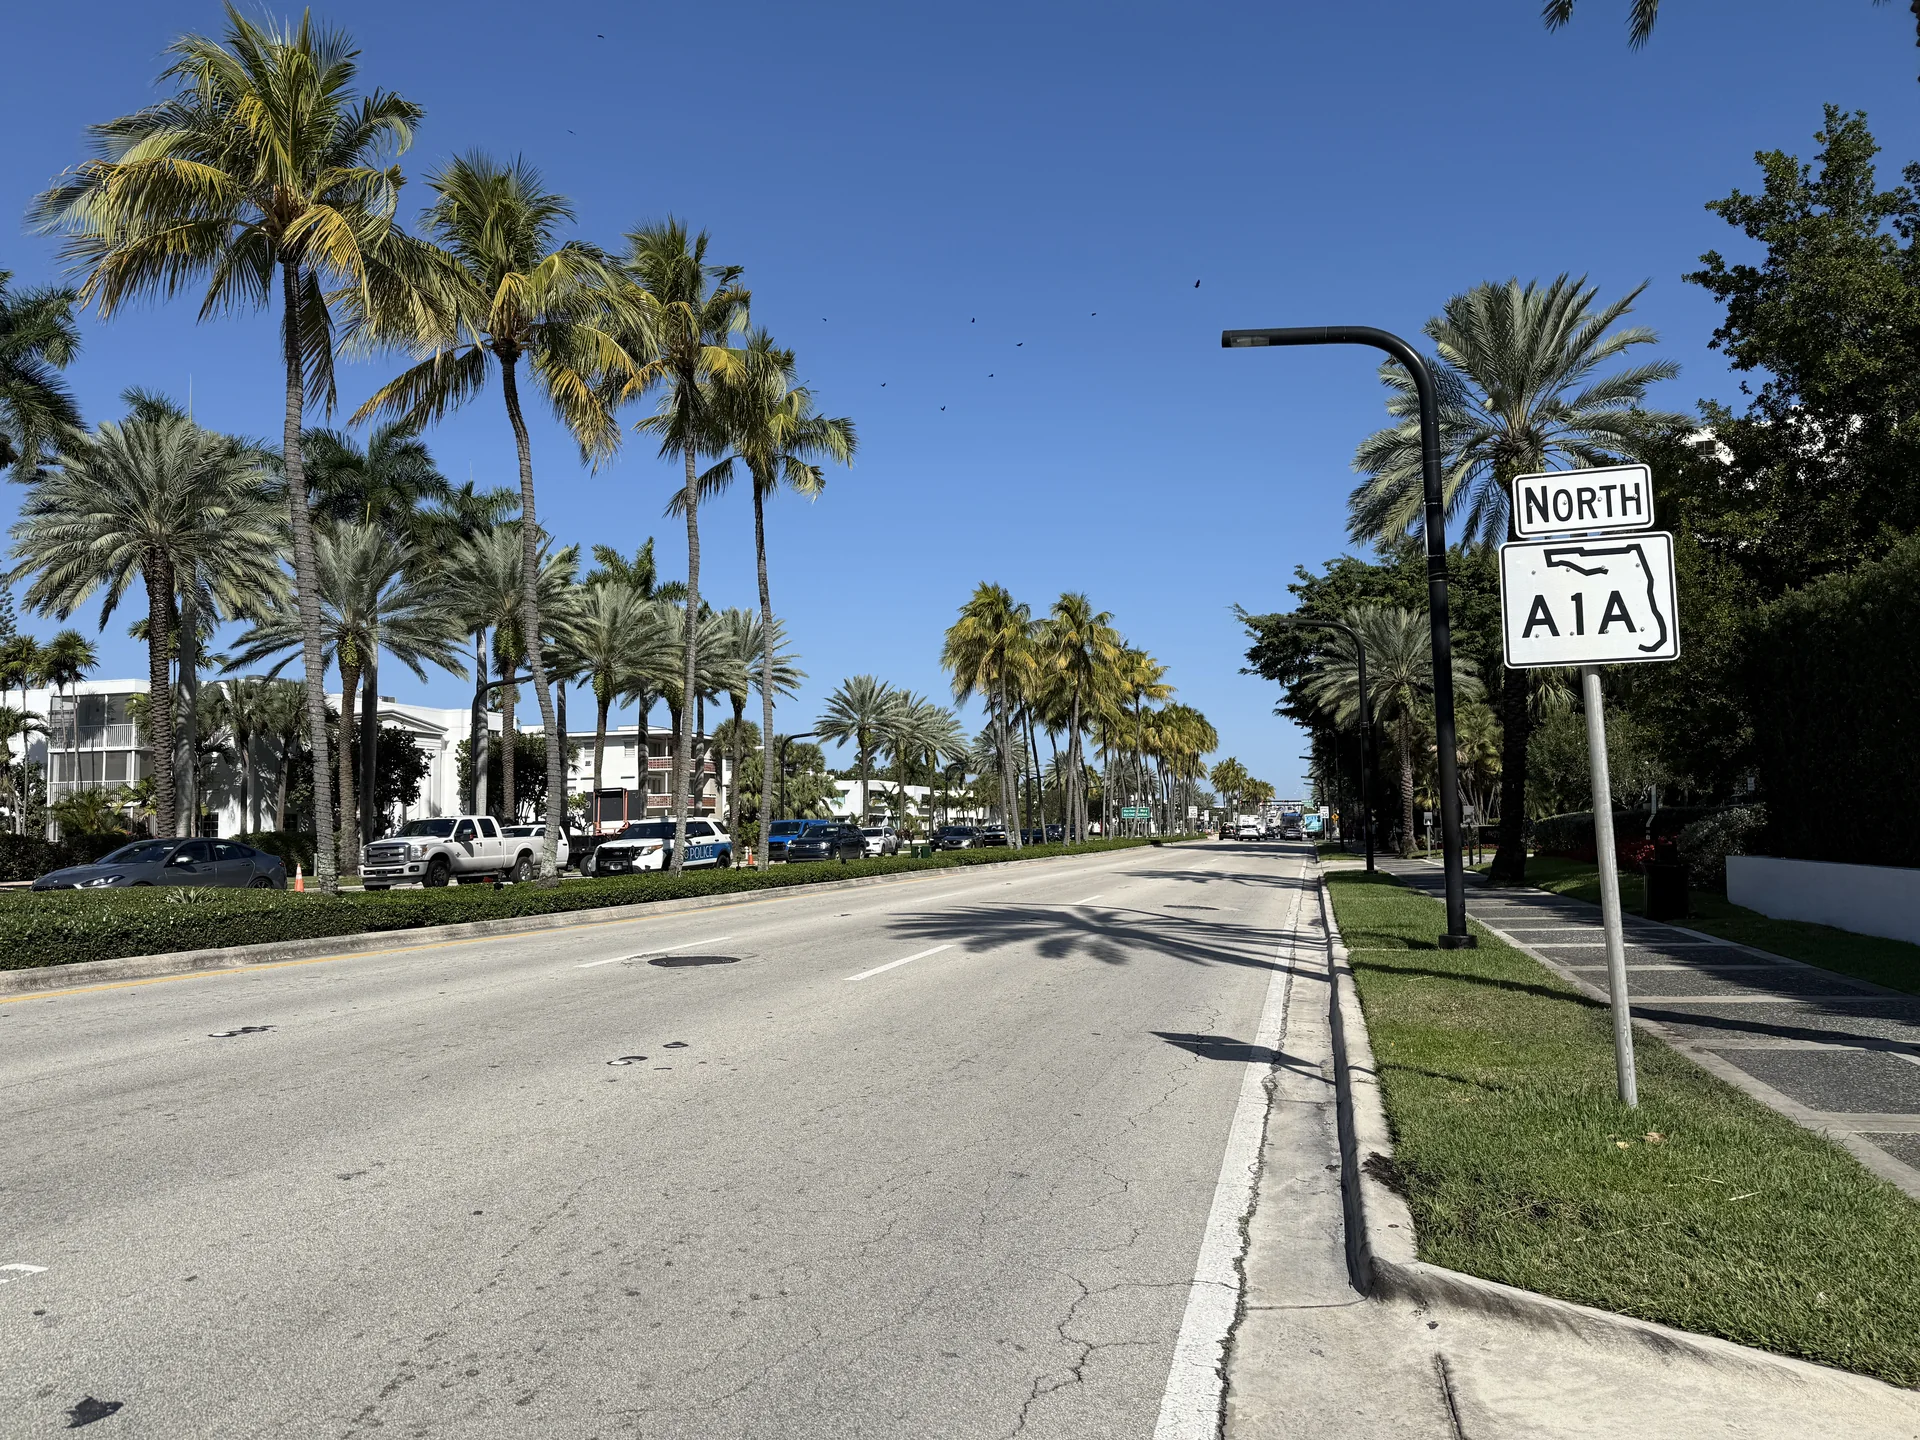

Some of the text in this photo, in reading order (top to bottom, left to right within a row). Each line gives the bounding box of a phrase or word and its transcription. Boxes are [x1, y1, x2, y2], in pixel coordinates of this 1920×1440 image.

[1524, 482, 1642, 524] NORTH
[1521, 590, 1637, 638] A1A
[690, 845, 713, 859] POLICE
